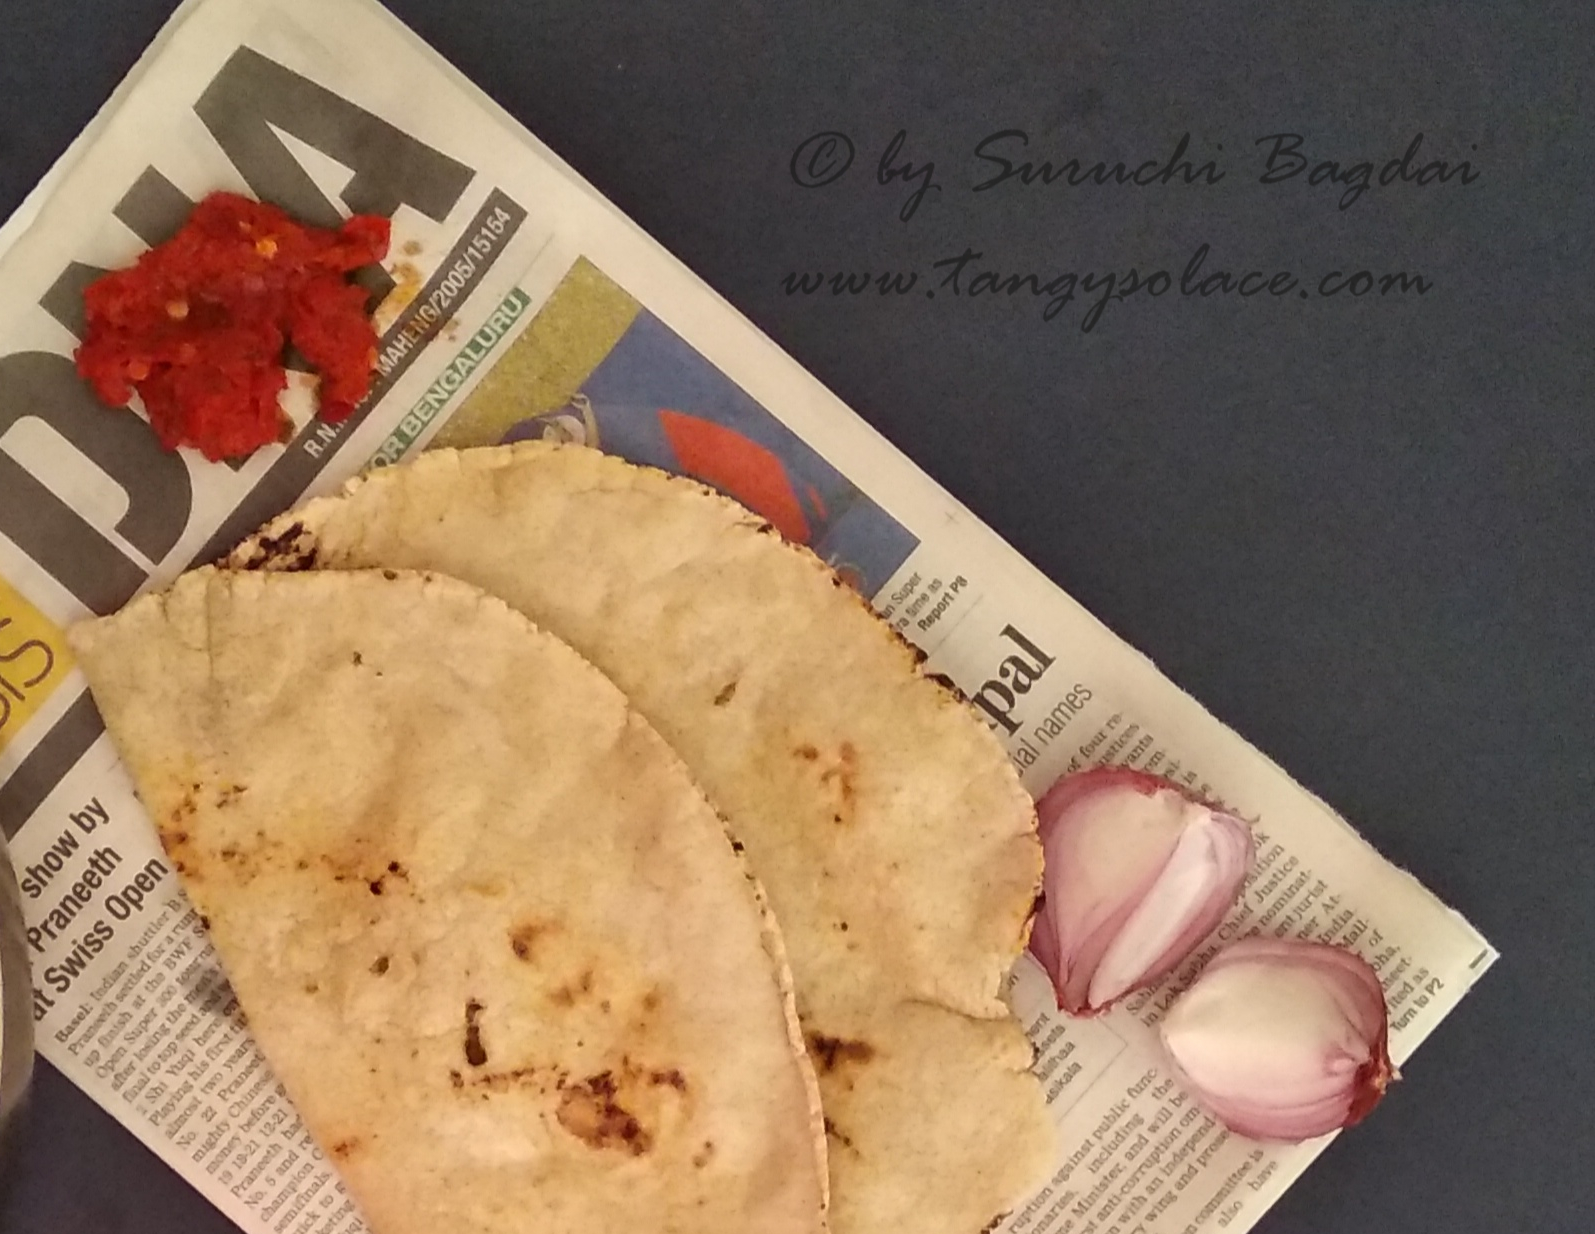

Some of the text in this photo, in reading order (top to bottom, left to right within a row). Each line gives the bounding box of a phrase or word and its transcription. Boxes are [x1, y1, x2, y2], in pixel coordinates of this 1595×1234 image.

[376, 206, 511, 378] MAHENG/2005/15154
[401, 292, 521, 436] BENGALURU
[891, 572, 921, 604] Super
[905, 578, 941, 617] time as
[917, 575, 967, 631] Report P8
[1033, 683, 1092, 746] names
[1066, 757, 1081, 773] of
[1079, 731, 1106, 758] four
[20, 796, 110, 898] show by
[24, 846, 122, 953] Praneeth
[43, 918, 113, 993] Swiss
[104, 857, 168, 921] Open
[1291, 879, 1327, 919] jurist
[1142, 1011, 1158, 1027] in
[1154, 985, 1181, 1011] Lok
[1217, 902, 1253, 943] Chief
[1254, 855, 1296, 904] Justice
[1367, 929, 1383, 947] of
[1390, 977, 1443, 1031] Turn to P2
[1412, 967, 1428, 983] as
[1087, 1077, 1174, 1174] including the
[1123, 1133, 1149, 1161] and
[1146, 1106, 1173, 1133] will
[1168, 1089, 1189, 1107] be
[1008, 1186, 1053, 1234] ruption
[1051, 1139, 1094, 1186] against
[1091, 1098, 1130, 1140] public
[1096, 1127, 1181, 1221] anti-corruption
[1145, 1190, 1177, 1222] wing
[1173, 1163, 1198, 1190] and
[1195, 1161, 1252, 1223] committee
[1217, 1199, 1243, 1227] also
[1246, 1160, 1277, 1191] have
[1117, 1194, 1147, 1223] with
[1145, 1176, 1163, 1194] an
